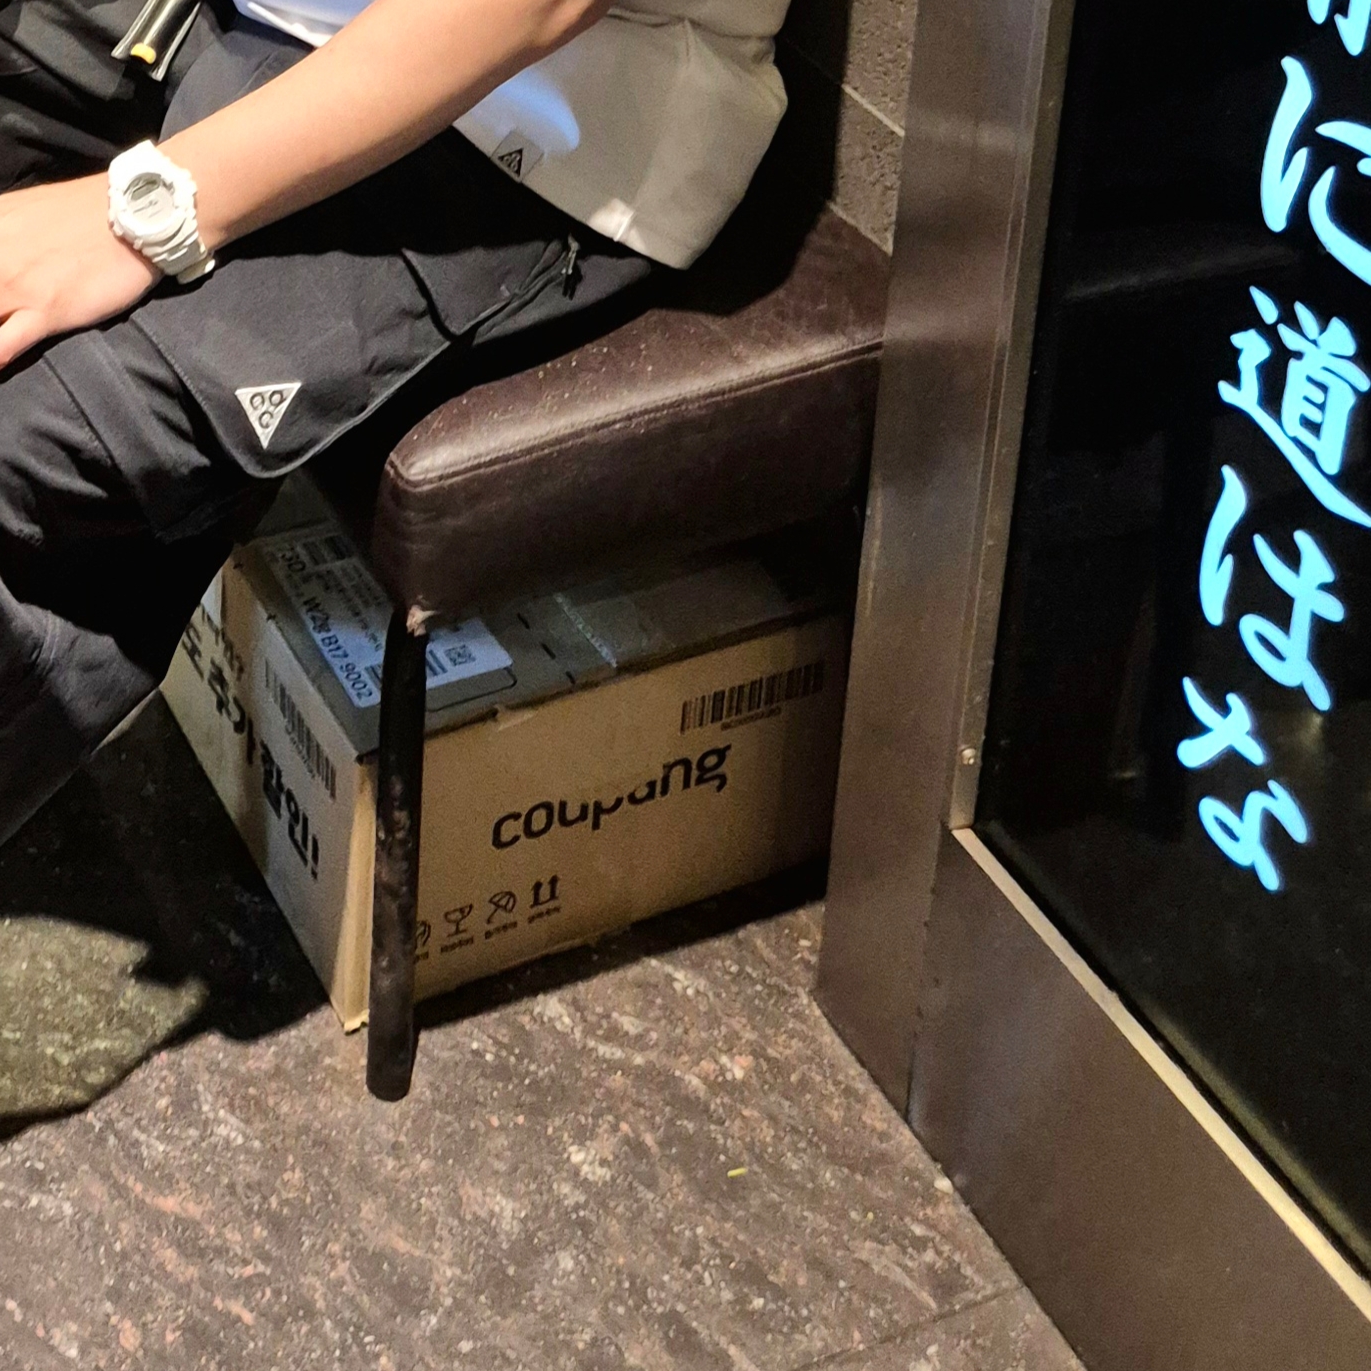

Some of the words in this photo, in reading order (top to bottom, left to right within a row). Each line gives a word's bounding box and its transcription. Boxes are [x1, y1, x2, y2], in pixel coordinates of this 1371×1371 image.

[320, 633, 349, 660] B17
[339, 662, 373, 701] 9002
[491, 743, 732, 851] coupang
